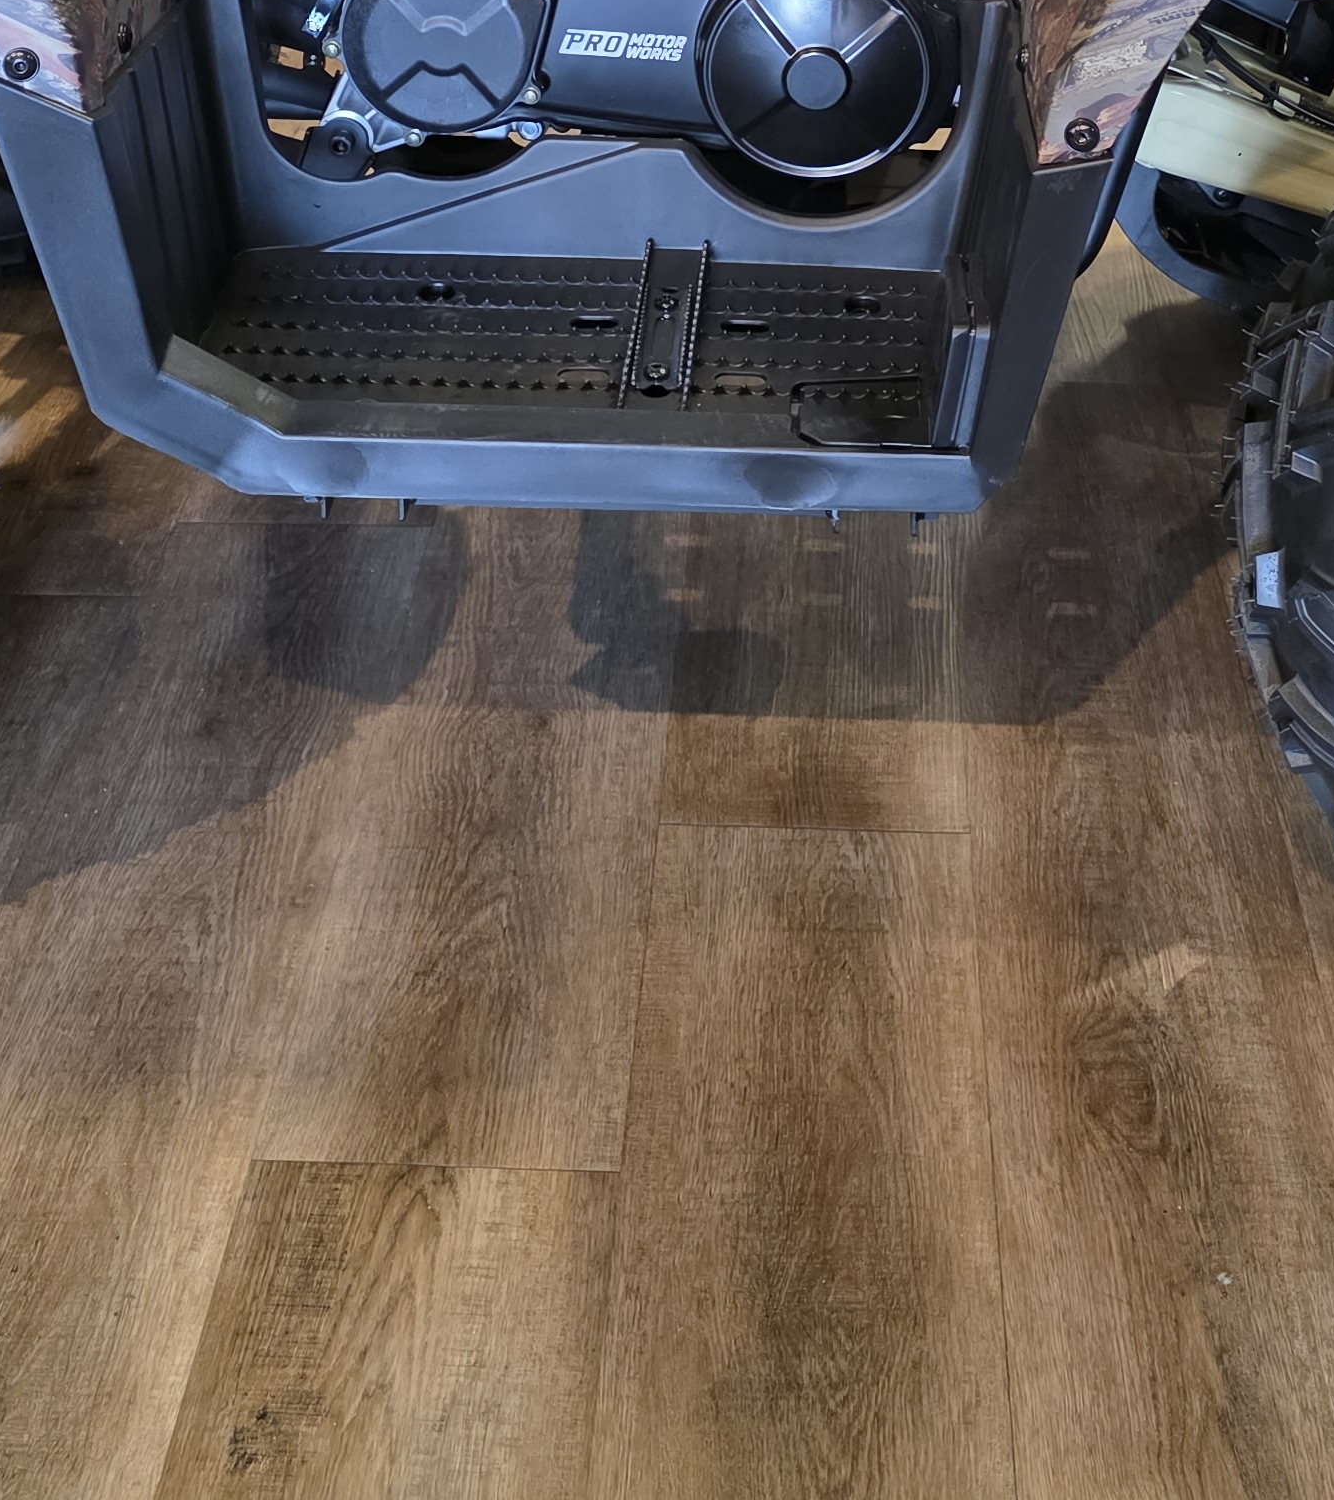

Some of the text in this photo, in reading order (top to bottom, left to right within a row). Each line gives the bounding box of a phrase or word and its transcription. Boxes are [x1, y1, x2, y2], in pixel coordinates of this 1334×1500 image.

[562, 30, 687, 55] PRO MOTOR
[626, 46, 683, 61] WORKS
